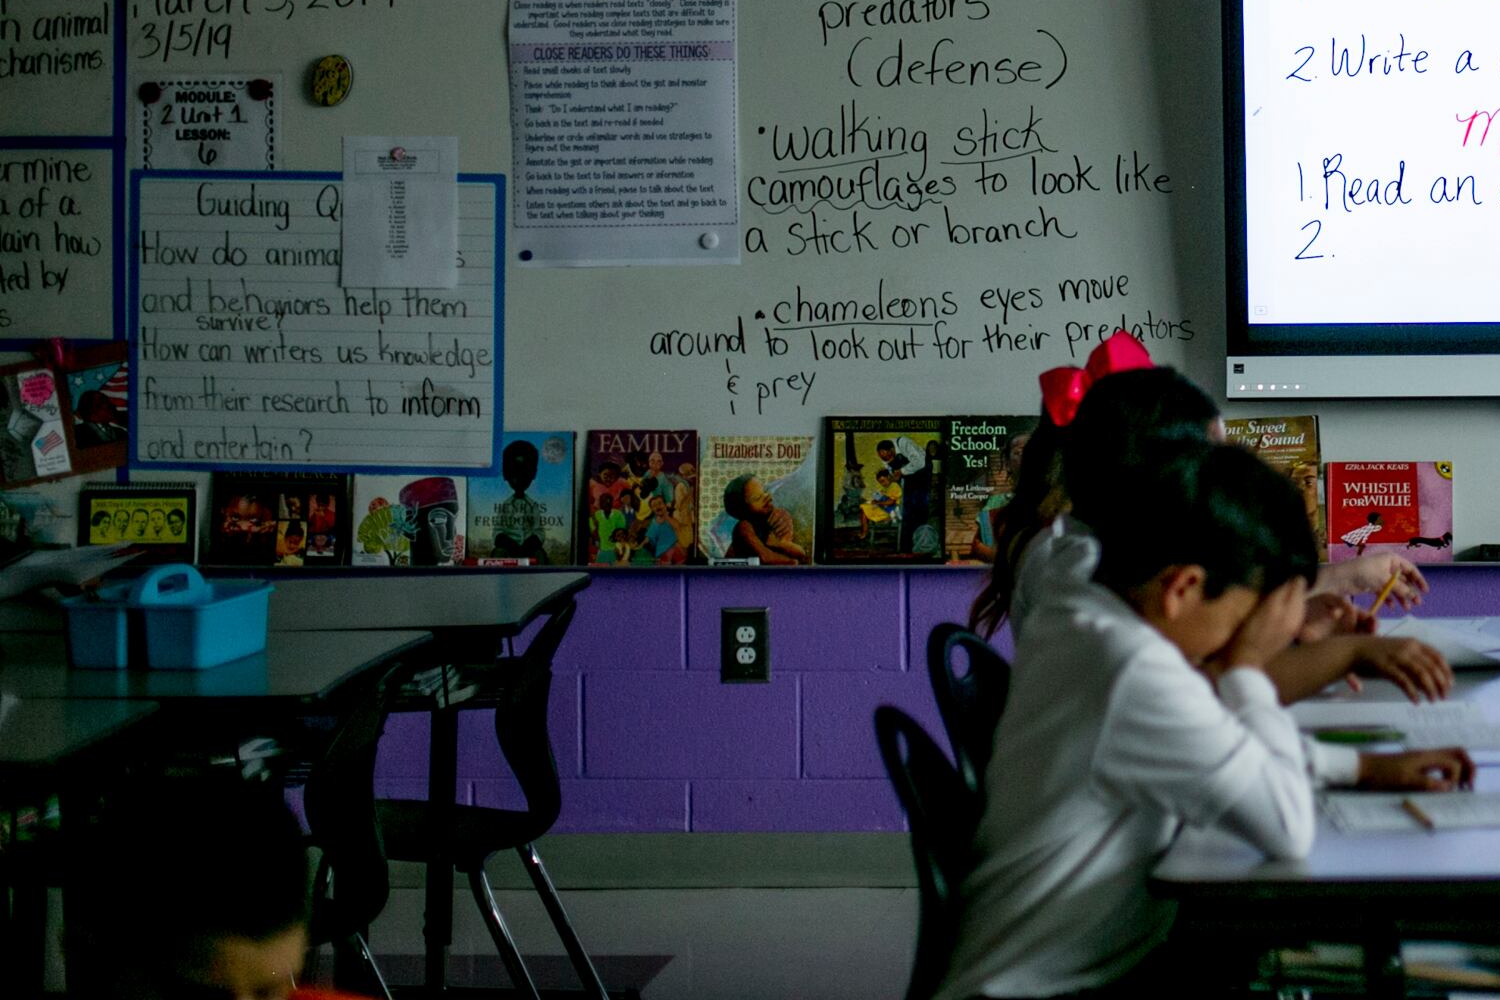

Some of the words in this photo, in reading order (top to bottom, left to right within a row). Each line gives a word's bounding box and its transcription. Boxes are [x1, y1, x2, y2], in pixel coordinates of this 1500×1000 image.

[33, 3, 109, 41] animal
[138, 18, 232, 62] 3/5/19
[533, 48, 564, 60] CLOSE
[568, 47, 613, 60] READERS
[617, 47, 631, 59] DO
[635, 46, 667, 58] THESE
[1332, 33, 1429, 77] Write
[1455, 50, 1479, 71] a
[846, 29, 1067, 90] (defense)
[161, 104, 175, 124] 2
[181, 105, 223, 123] Unit
[231, 105, 248, 123] 1
[175, 91, 236, 103] MODULE:
[175, 129, 231, 141] LESSON:
[772, 100, 927, 180] walking
[953, 105, 1059, 157] stick
[198, 143, 217, 166] 6
[747, 160, 956, 211] camouflages
[975, 162, 1007, 193] to
[1031, 154, 1100, 195] look
[1115, 154, 1173, 195] like
[1323, 153, 1412, 212] Read
[1430, 171, 1482, 205] an
[197, 181, 290, 231] Guiding
[744, 227, 767, 253] a
[788, 211, 877, 255] stick
[892, 222, 929, 245] or
[944, 205, 1077, 243] branch
[140, 233, 198, 266] How
[212, 230, 247, 266] do
[143, 278, 192, 314] and
[208, 278, 331, 318] behaviors
[344, 288, 392, 321] help
[400, 289, 468, 318] them
[774, 280, 958, 325] chameleons
[980, 282, 1043, 325] eyes
[1058, 274, 1129, 303] move
[196, 311, 288, 332] survive?
[650, 316, 746, 356] around
[764, 327, 788, 357] to
[812, 328, 868, 361] look
[878, 330, 922, 360] out
[933, 322, 973, 361] for
[983, 319, 1049, 354] their
[142, 328, 189, 360] How
[198, 343, 231, 362] can
[244, 332, 322, 364] writers
[337, 344, 368, 364] us
[377, 330, 494, 378] knowledge
[144, 376, 197, 412] from
[198, 377, 246, 412] their
[262, 380, 350, 414] research
[368, 381, 388, 414] to
[401, 377, 481, 419] inform
[756, 371, 816, 414] prey
[147, 429, 185, 460] and
[193, 428, 313, 461] entertain?
[599, 433, 690, 454] FAMILY
[951, 421, 1007, 436] Freedom
[951, 436, 1000, 452] School,
[1246, 420, 1287, 435] Sweet
[1260, 433, 1305, 449] Sound
[777, 443, 801, 459] Doll
[963, 455, 988, 468] Yes!
[1343, 482, 1411, 495] WHISTLE
[538, 515, 564, 526] BOX
